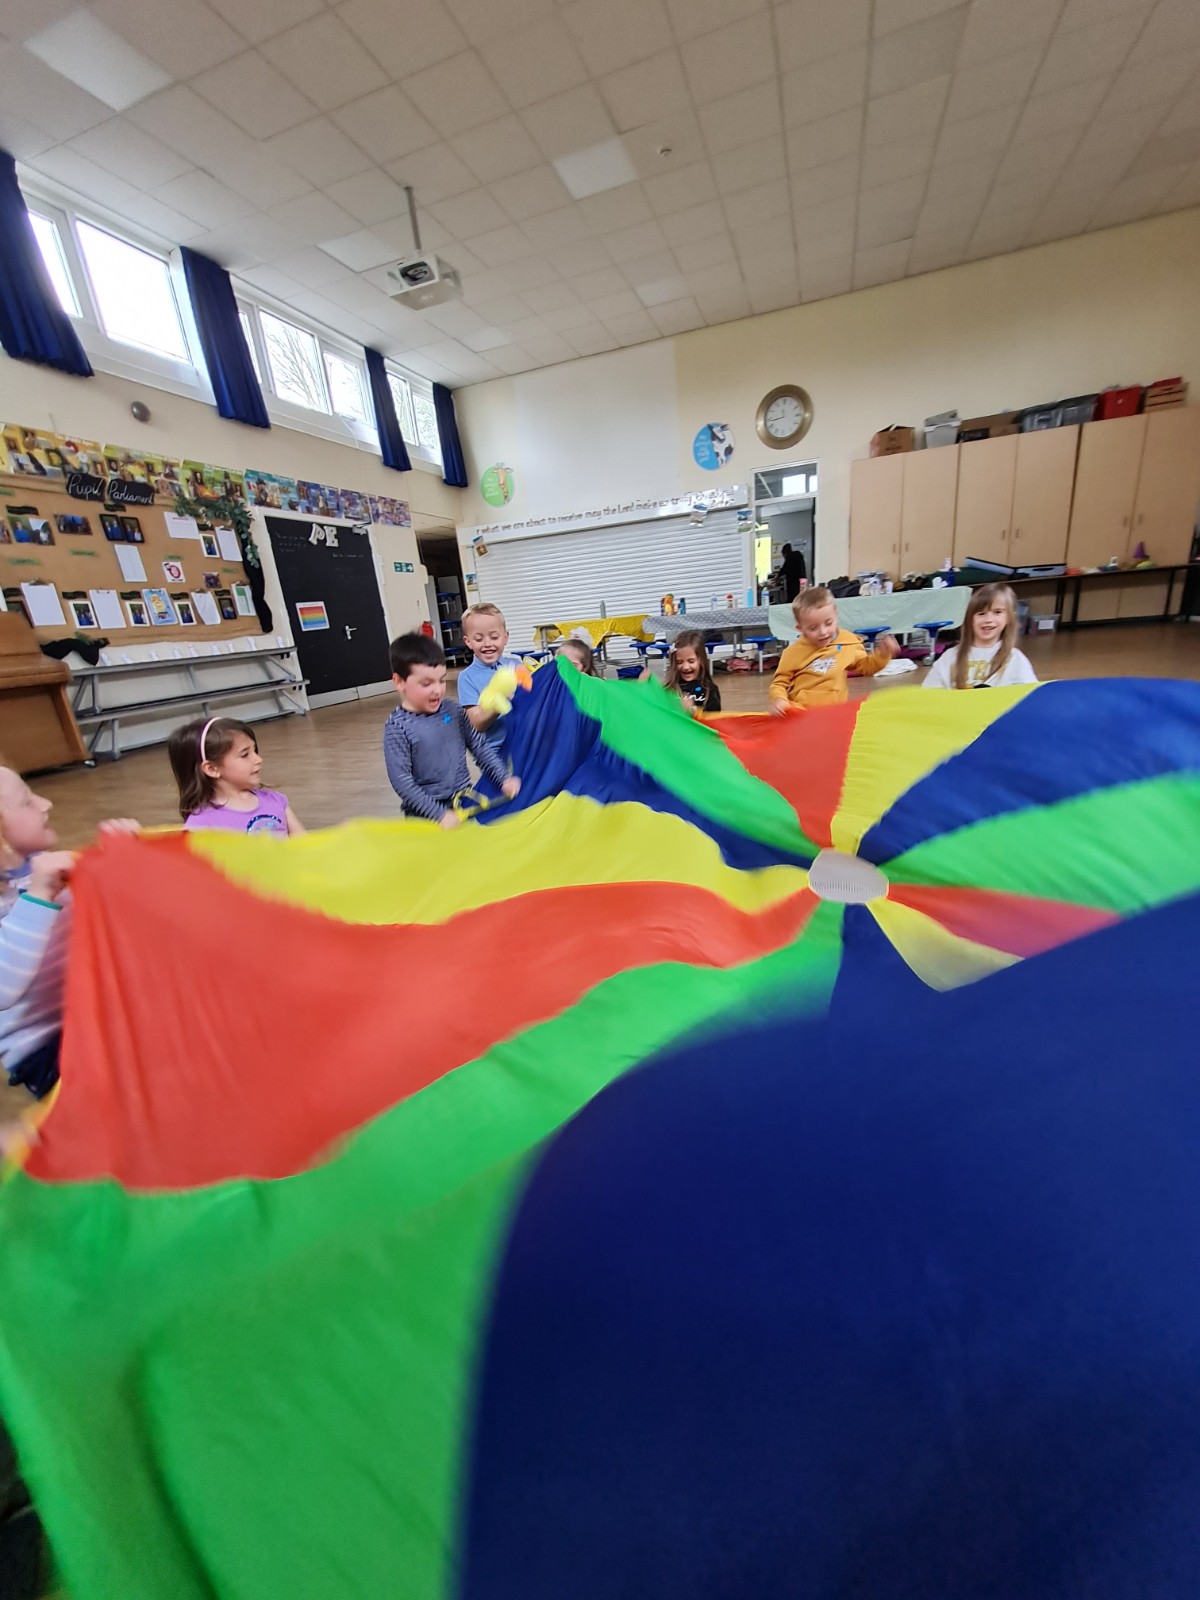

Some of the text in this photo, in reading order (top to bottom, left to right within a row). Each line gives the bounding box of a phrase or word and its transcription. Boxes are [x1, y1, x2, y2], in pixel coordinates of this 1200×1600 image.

[69, 473, 153, 505] Pupil Parliament
[481, 525, 500, 534] what
[513, 522, 525, 530] are
[526, 518, 546, 528] about
[558, 513, 583, 523] receive
[585, 510, 602, 521] may
[603, 506, 617, 516] the
[617, 502, 635, 514] Lord
[308, 523, 339, 548] PE
